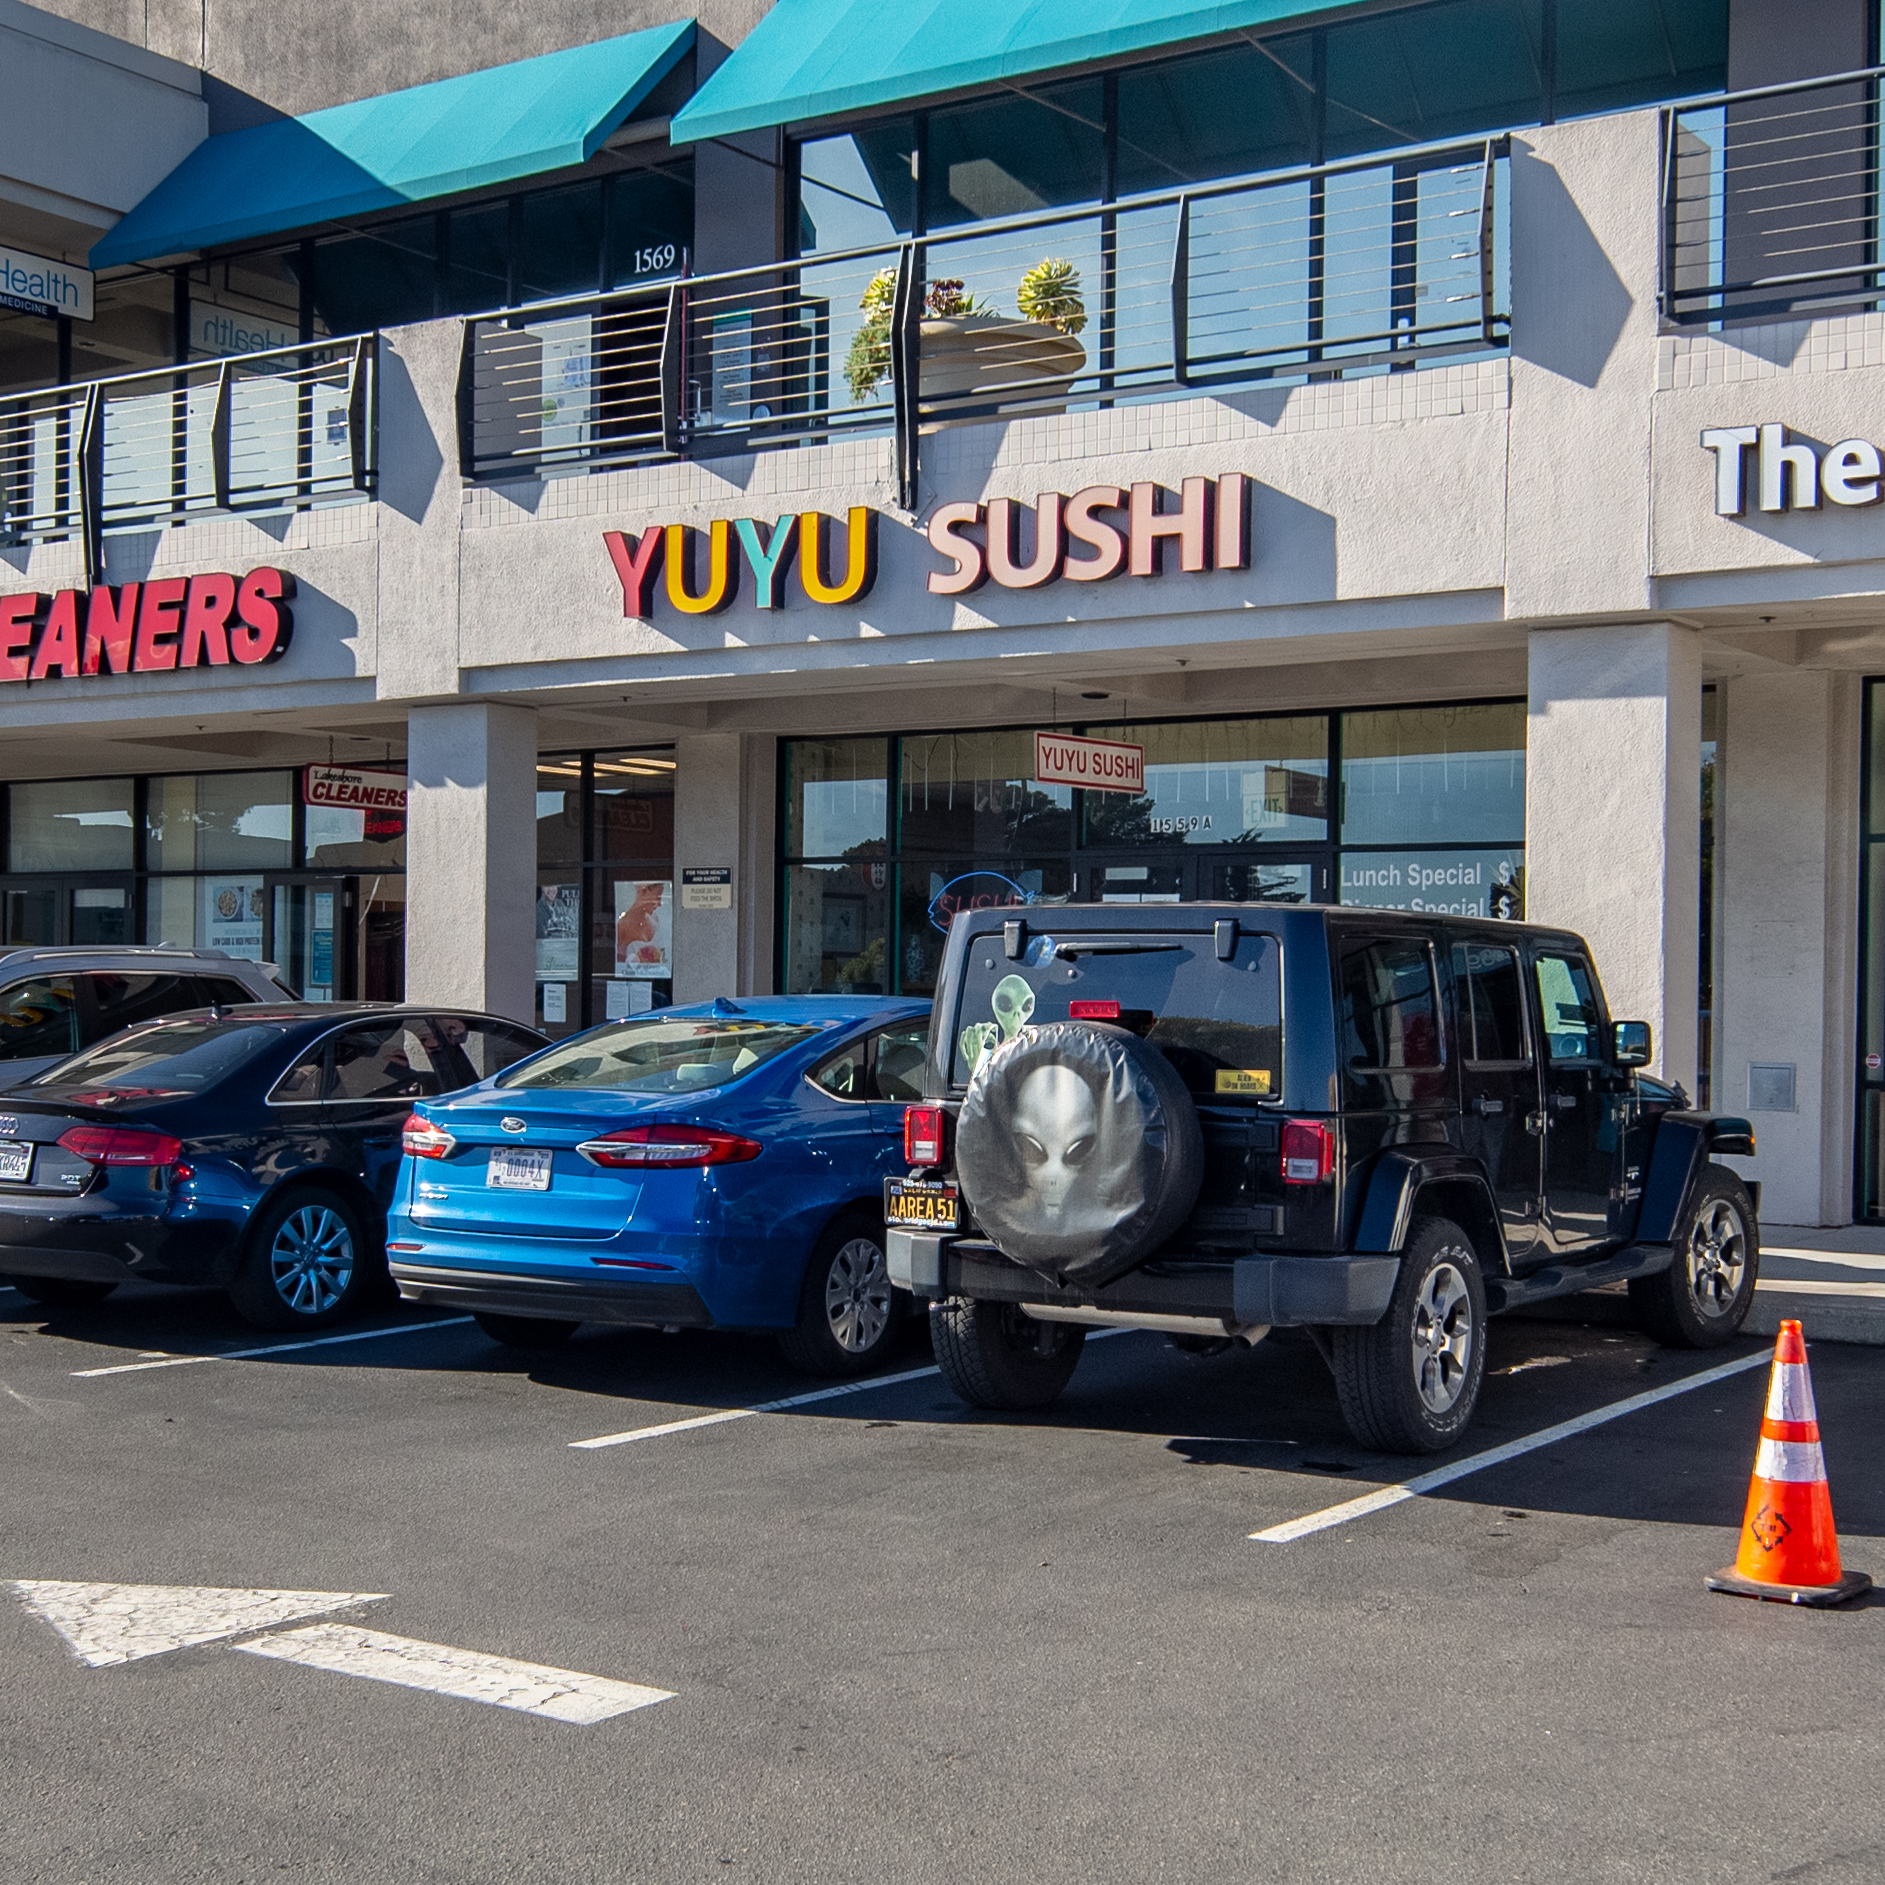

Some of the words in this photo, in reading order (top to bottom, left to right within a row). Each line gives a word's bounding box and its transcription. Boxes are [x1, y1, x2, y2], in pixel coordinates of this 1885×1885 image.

[633, 244, 676, 275] 1569
[1700, 422, 1885, 516] The
[602, 505, 870, 619] YUYU
[925, 471, 1246, 595] SUSHI
[313, 767, 363, 784] Lakeshore
[1041, 745, 1087, 773] YUYU
[1092, 751, 1140, 780] SUSHI
[311, 781, 407, 808] CLEANERS
[1250, 798, 1280, 823] EXIT
[1340, 864, 1401, 887] Lunch
[1407, 862, 1482, 891] Special
